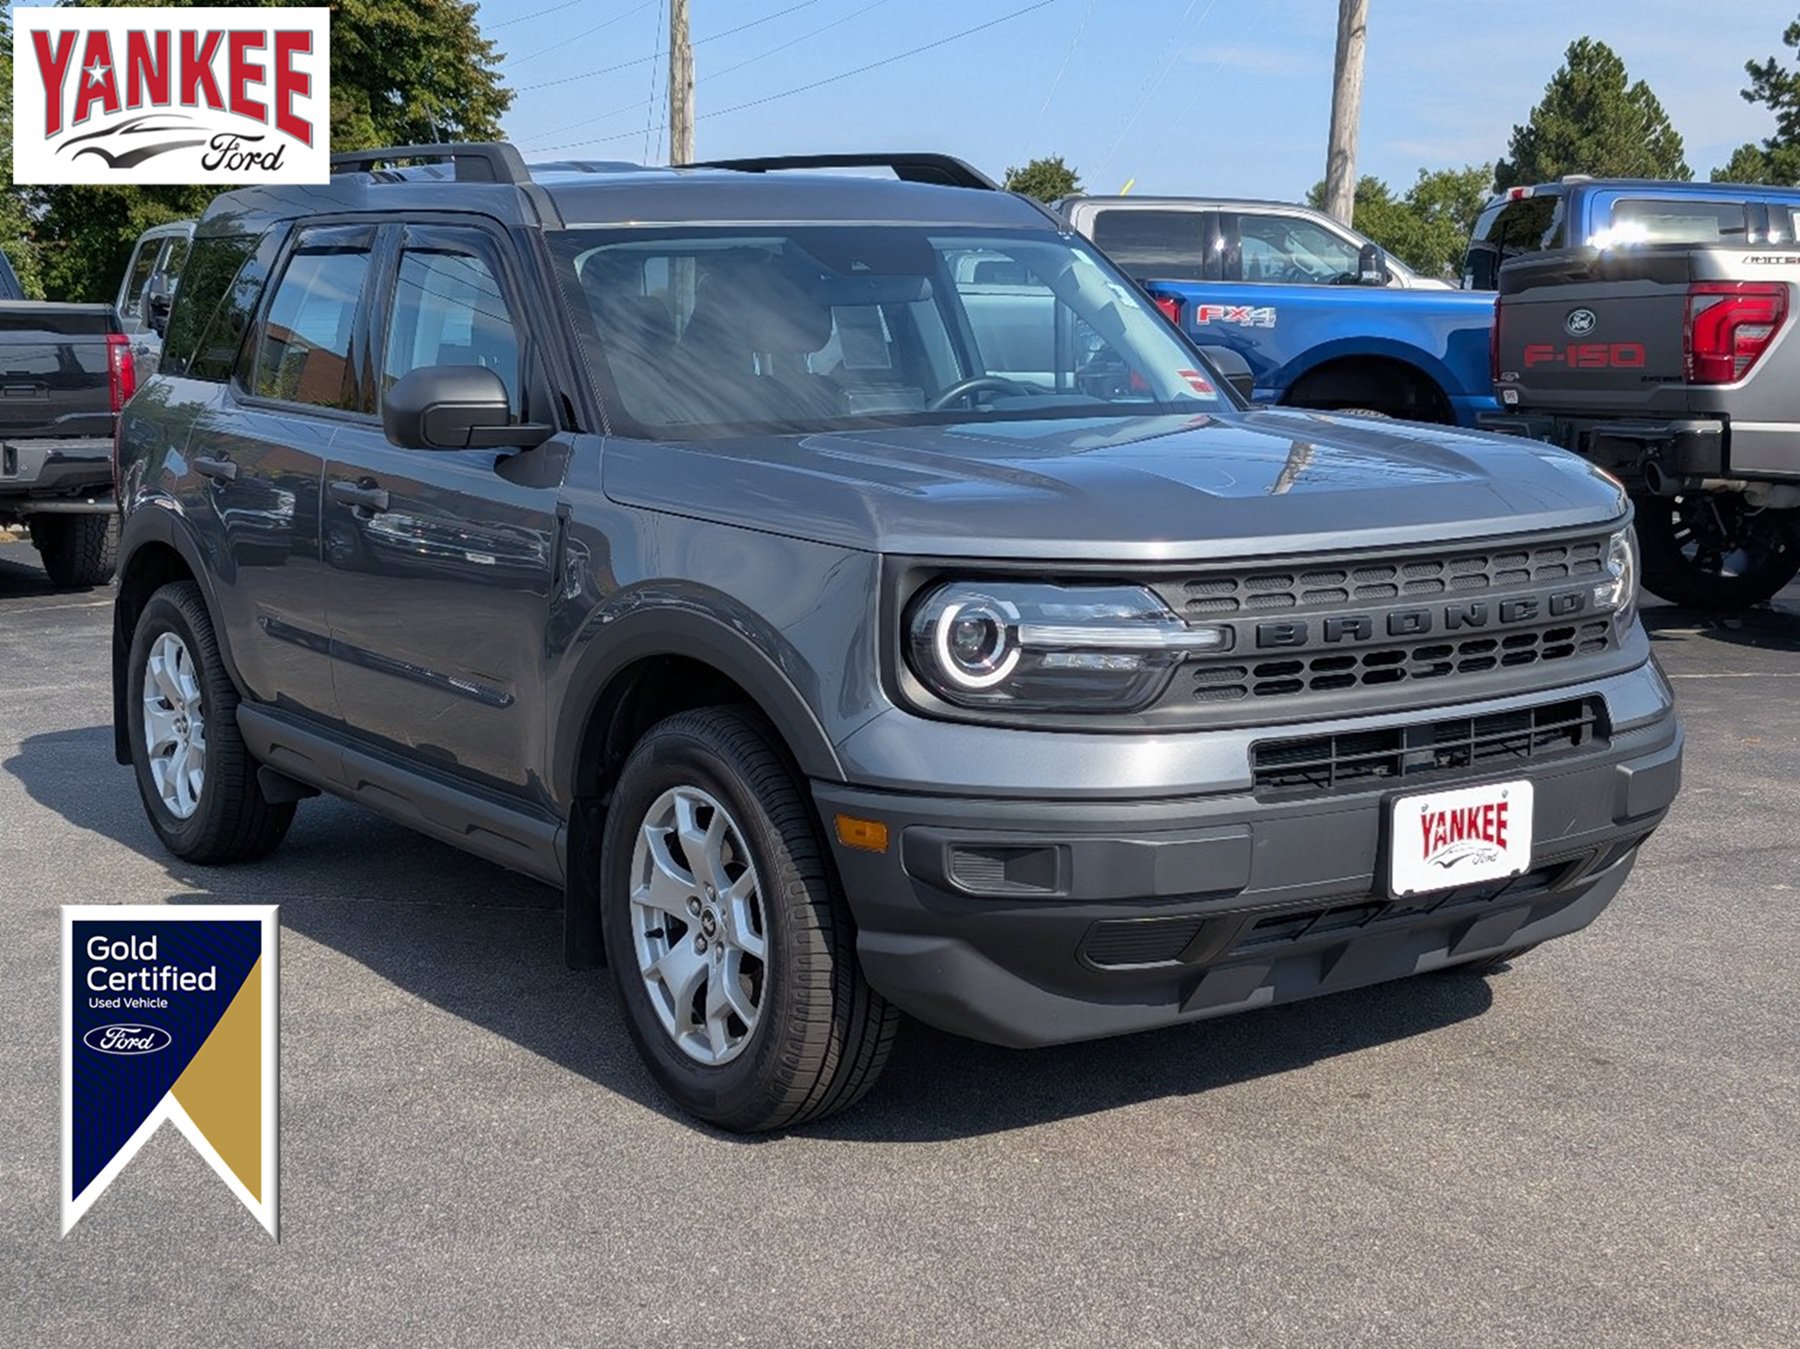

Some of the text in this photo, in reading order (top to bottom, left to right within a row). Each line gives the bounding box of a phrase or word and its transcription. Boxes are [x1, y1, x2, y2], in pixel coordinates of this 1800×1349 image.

[1196, 304, 1276, 327] FX4
[1523, 343, 1645, 368] F-150
[1255, 590, 1586, 648] BRONCO
[1420, 801, 1508, 860] YANKEE
